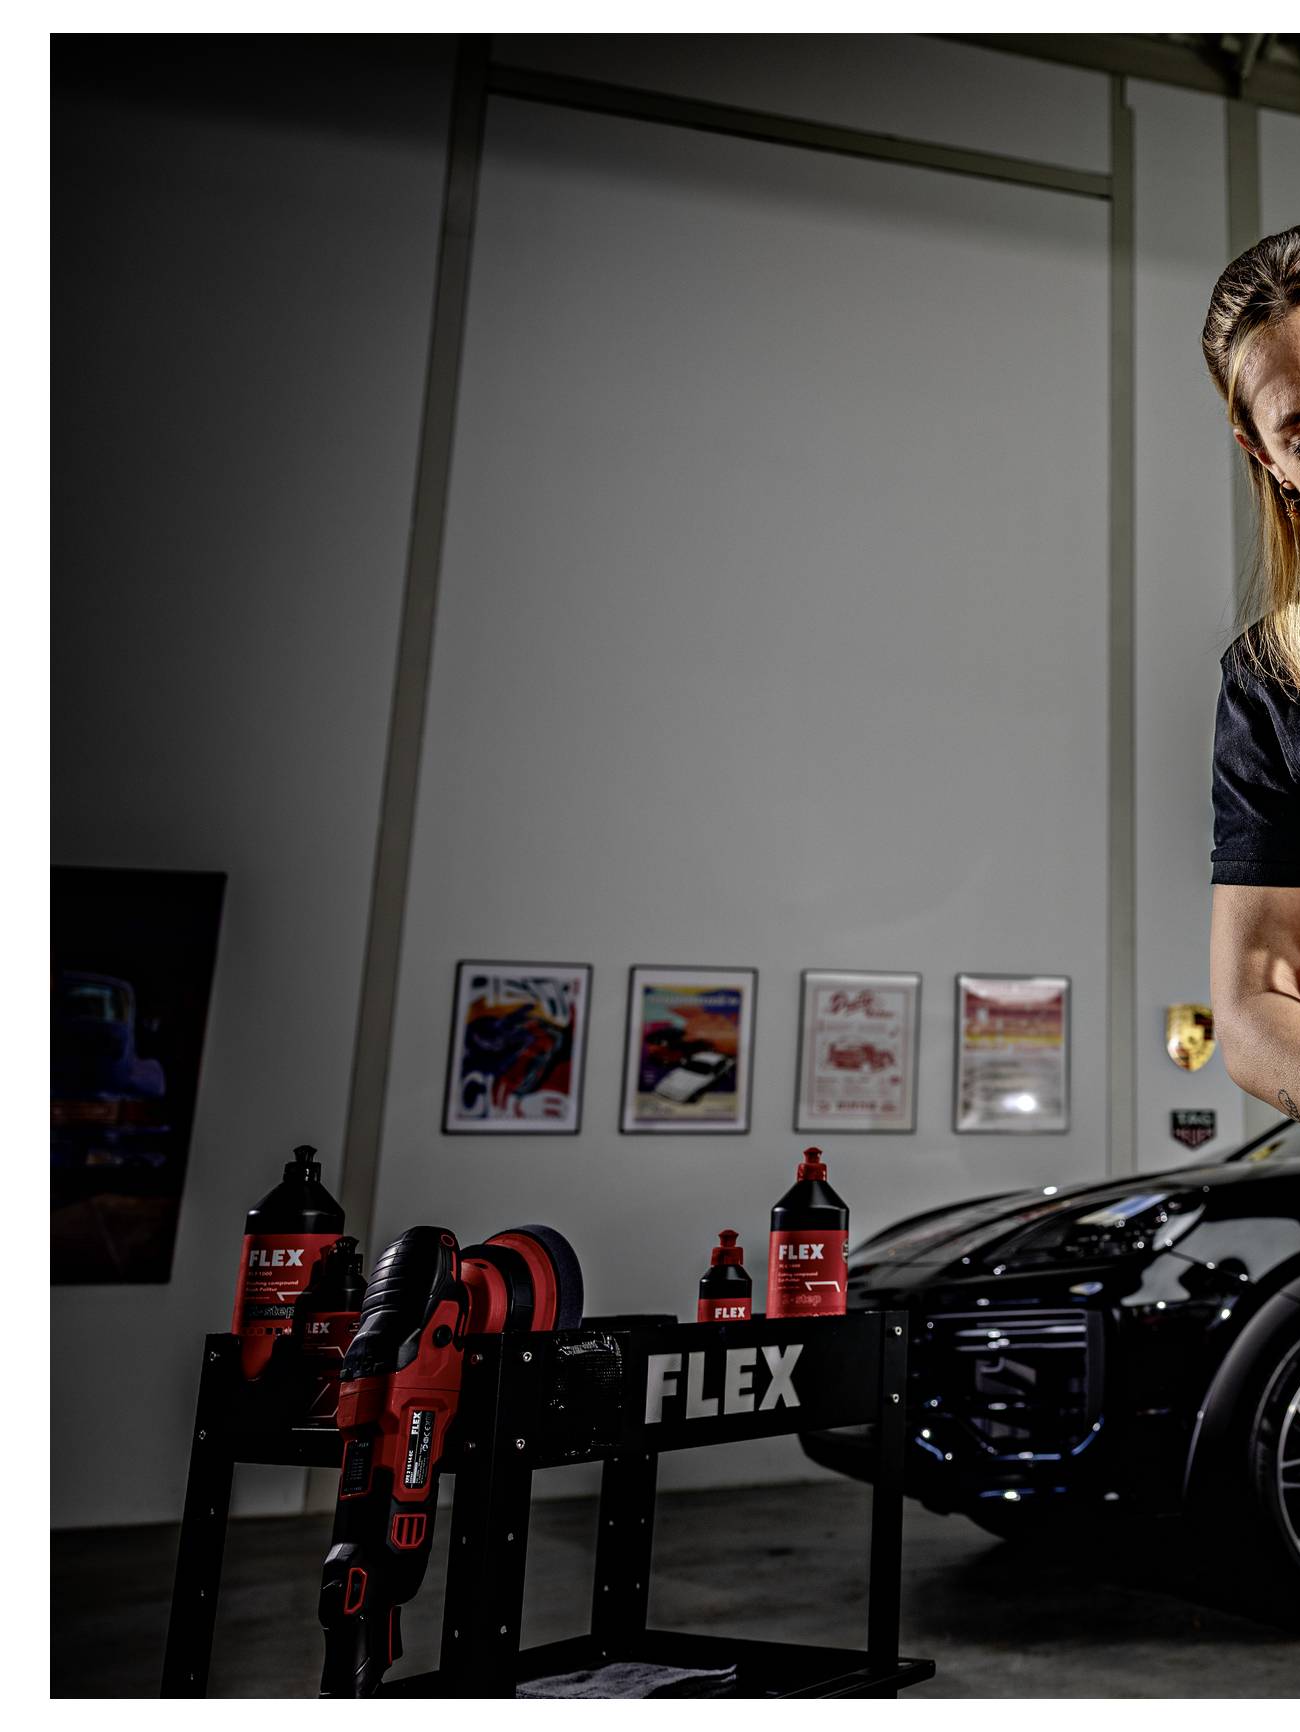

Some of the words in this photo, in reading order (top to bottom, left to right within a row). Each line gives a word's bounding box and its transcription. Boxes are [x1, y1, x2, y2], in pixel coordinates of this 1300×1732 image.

[249, 1249, 304, 1267] FLEX
[778, 1244, 824, 1260] FLEX
[714, 1307, 745, 1319] FLEX
[644, 1344, 804, 1424] FLEX
[411, 1411, 422, 1435] FLEX
